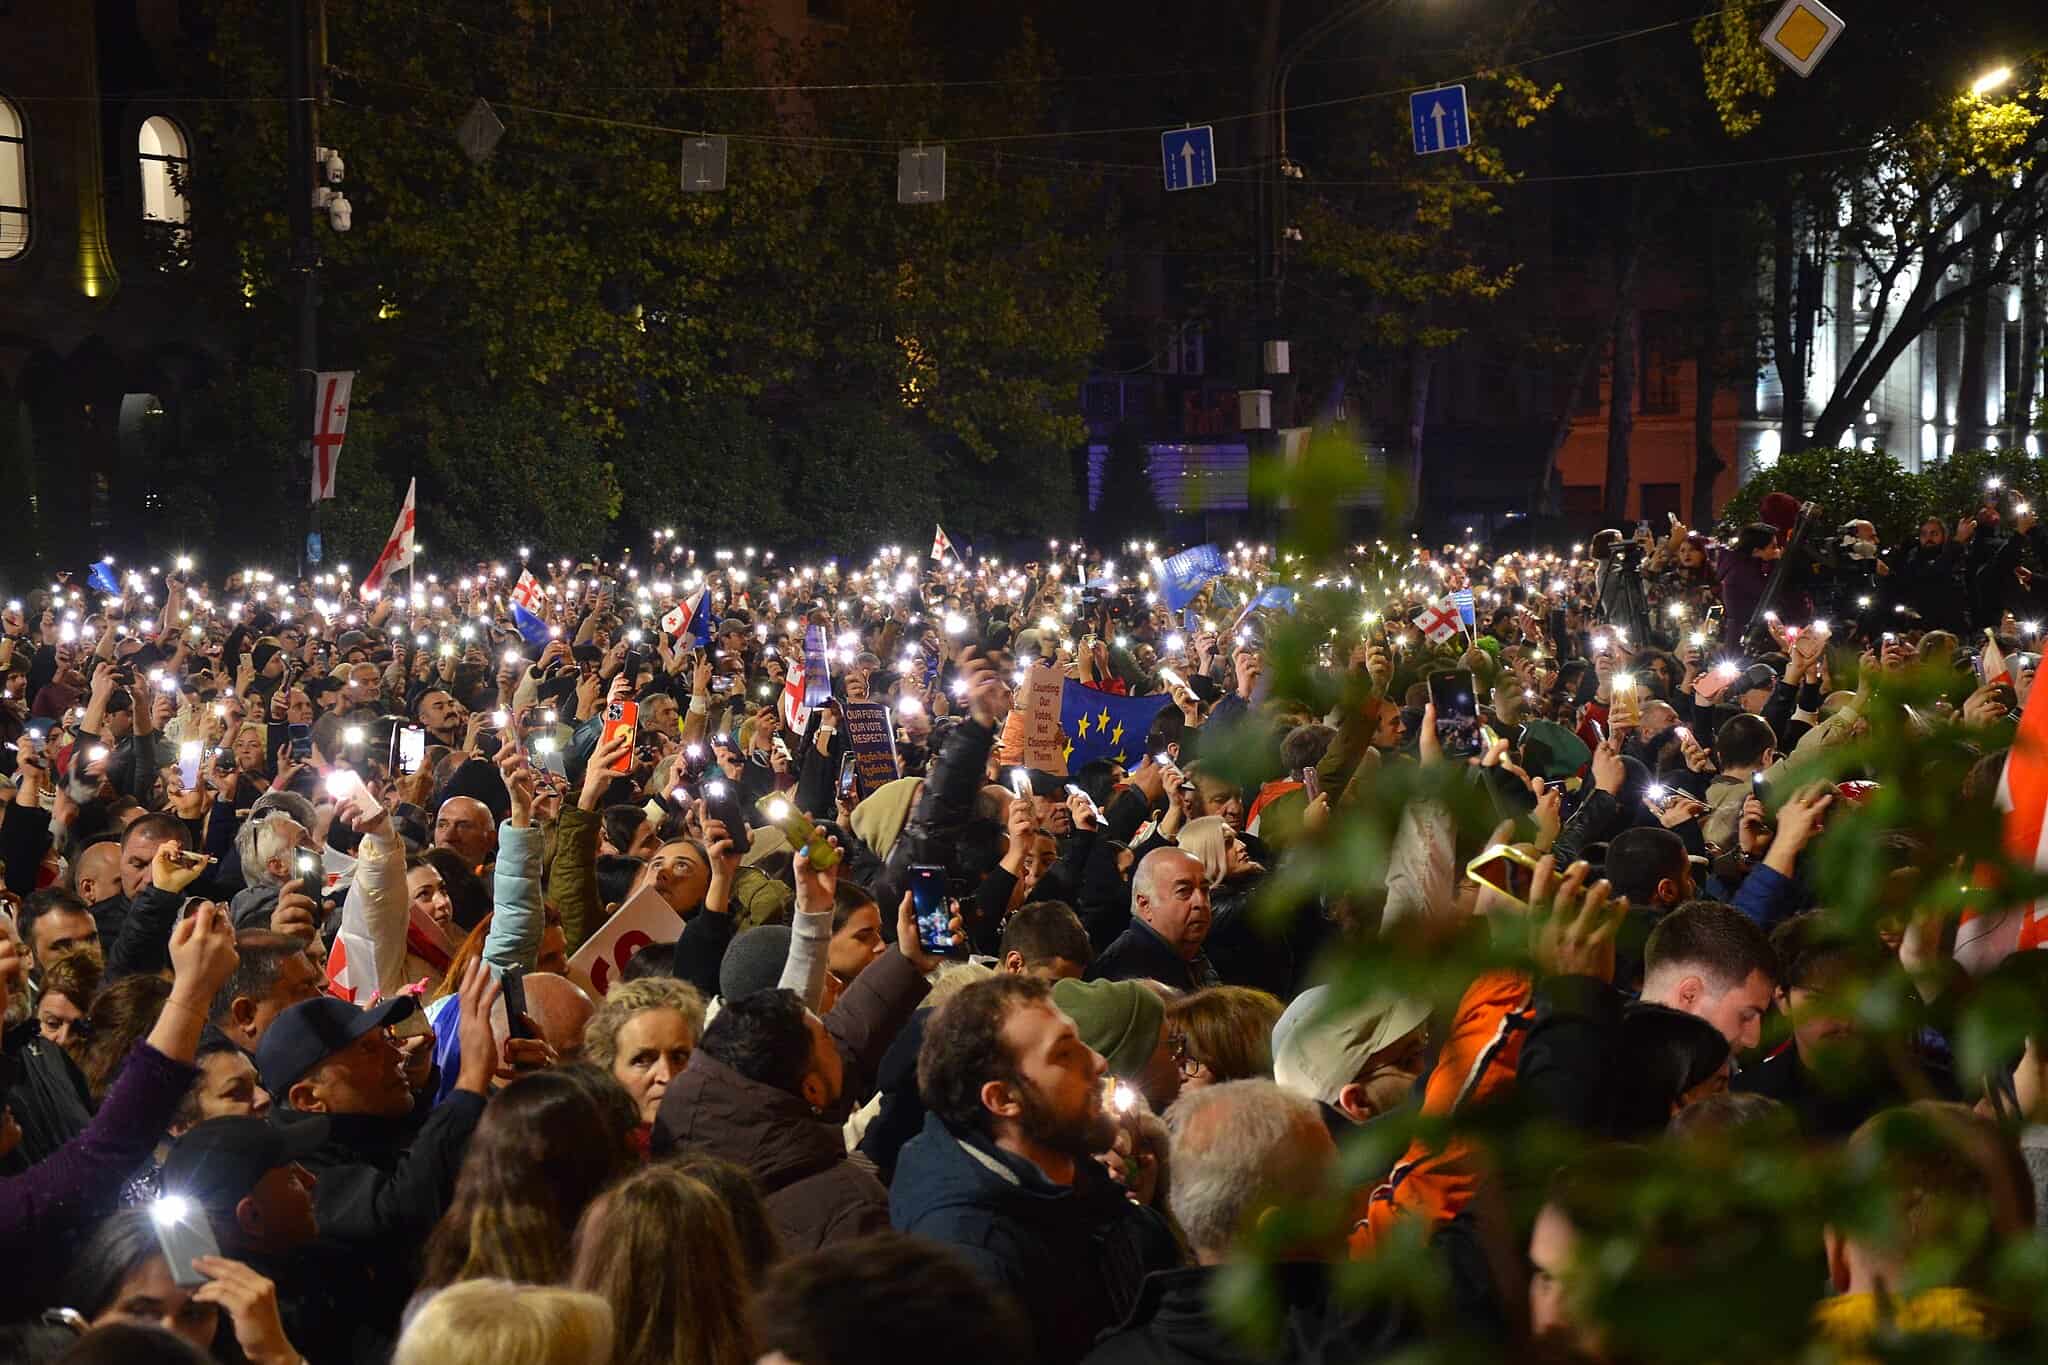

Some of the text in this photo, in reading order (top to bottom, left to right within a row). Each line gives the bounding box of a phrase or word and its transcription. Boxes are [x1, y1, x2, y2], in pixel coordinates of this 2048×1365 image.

[1033, 682, 1060, 696] Counting
[1039, 696, 1049, 706] Our
[847, 709, 885, 719] OUR FUTURE
[849, 721, 882, 732] OUR VOTE
[1037, 724, 1048, 734] Not
[1028, 736, 1057, 750] Changing
